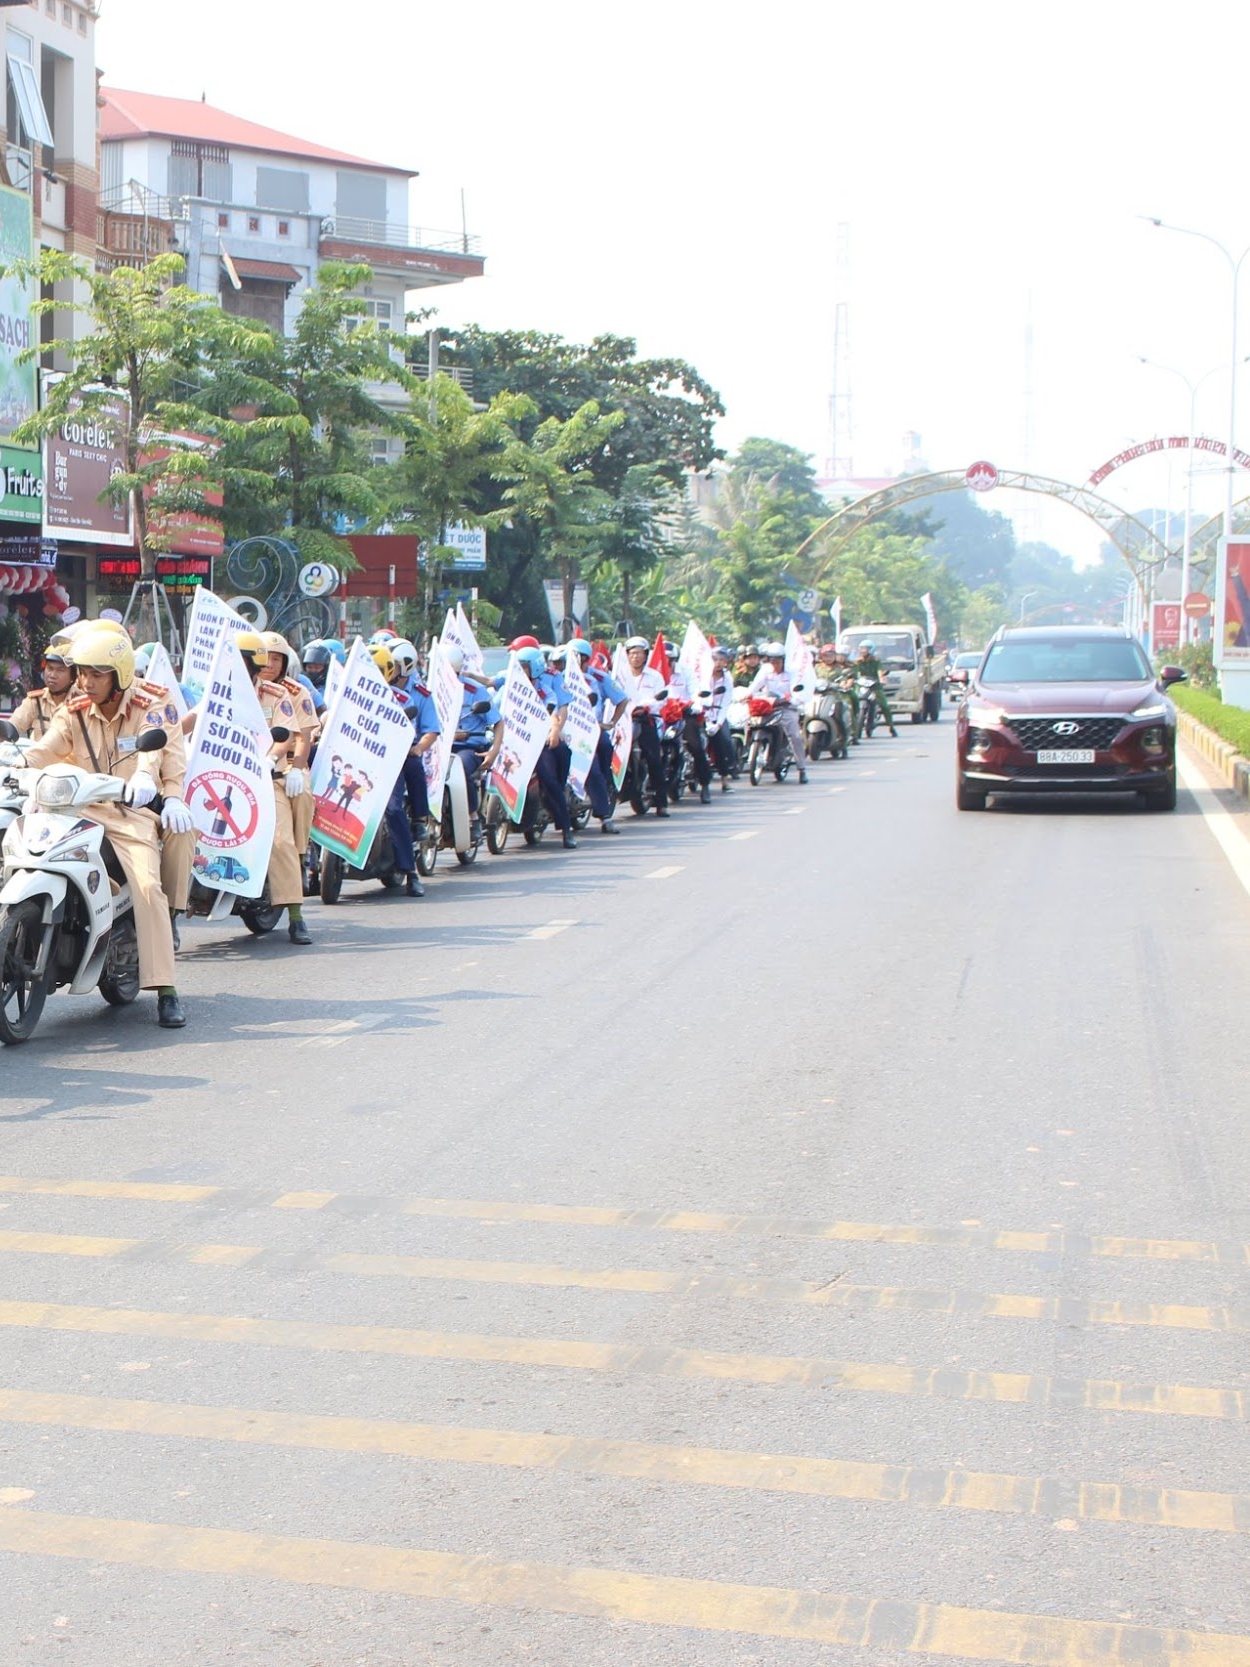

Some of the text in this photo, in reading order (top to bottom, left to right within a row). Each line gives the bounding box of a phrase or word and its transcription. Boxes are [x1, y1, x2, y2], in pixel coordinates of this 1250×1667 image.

[0, 314, 30, 352] SẠCH
[7, 466, 44, 497] Fruits
[357, 676, 388, 698] ATGT
[512, 681, 533, 699] ATGT
[200, 740, 263, 780] RƯỢU BIA
[224, 839, 237, 847] LÁI
